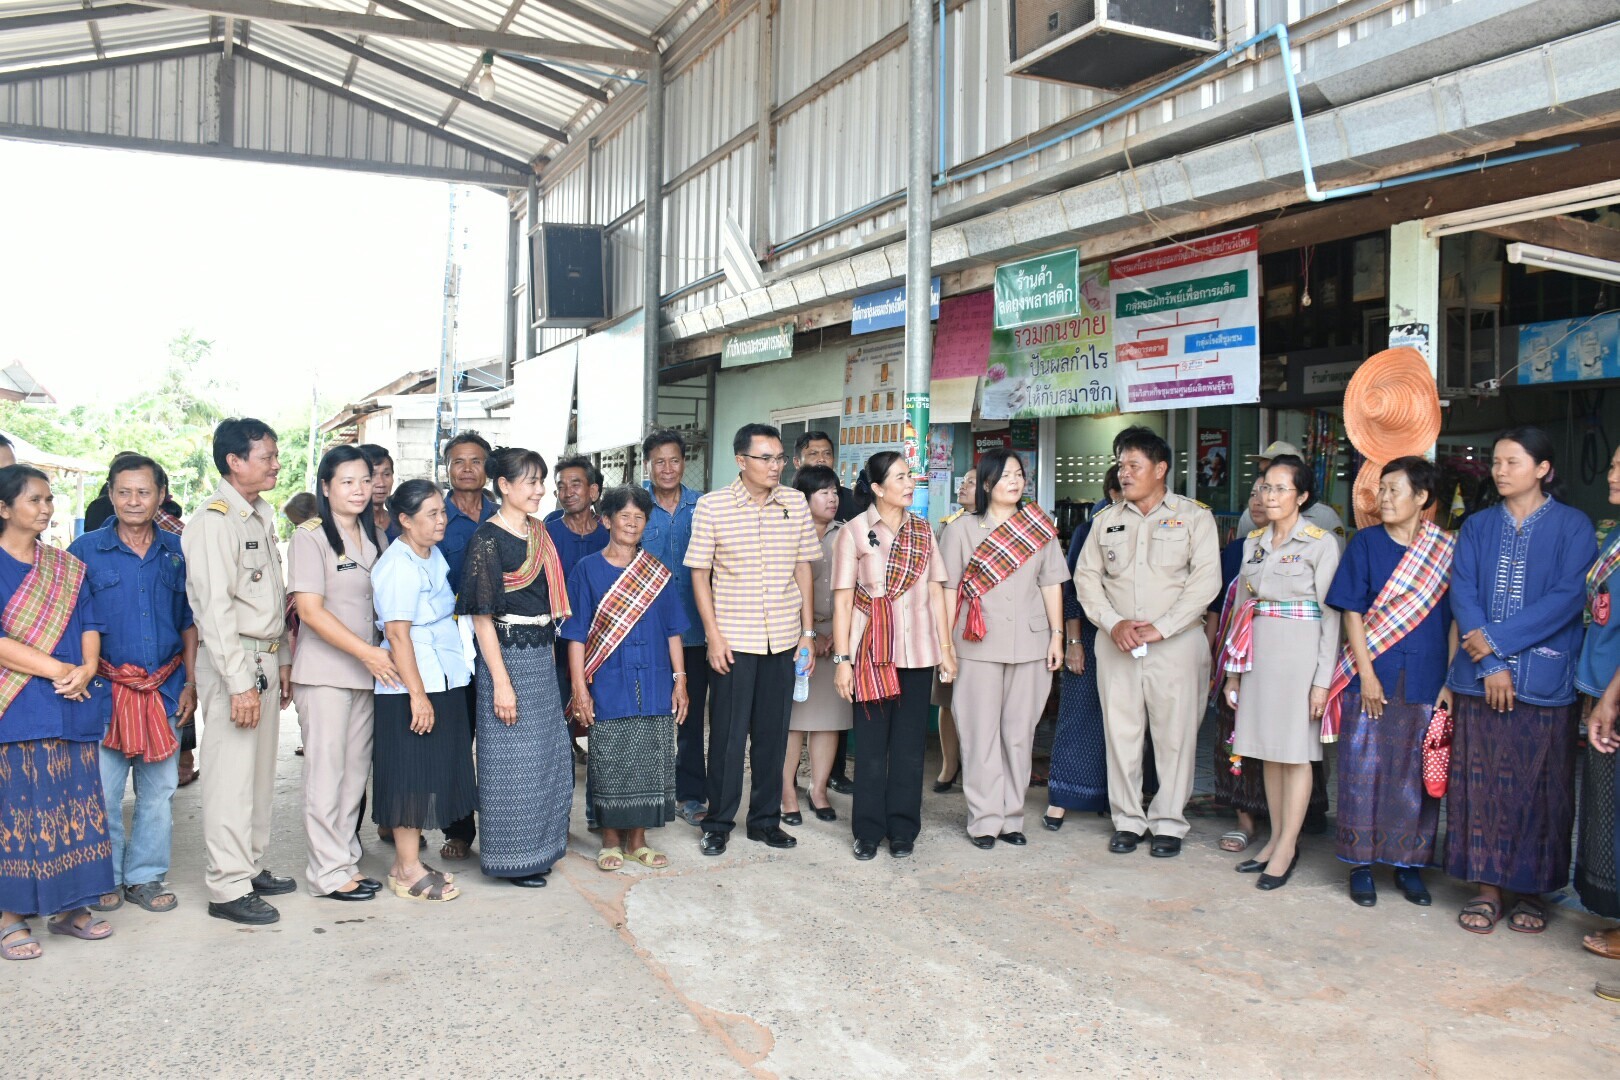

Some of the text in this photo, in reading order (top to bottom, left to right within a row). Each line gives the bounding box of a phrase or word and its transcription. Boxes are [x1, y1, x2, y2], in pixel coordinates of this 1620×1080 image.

[1017, 264, 1053, 290] ร้านค้า
[998, 283, 1073, 319] ลดถุงพลาสติก
[1125, 282, 1236, 313] กลุ่มออมทรัพย์เพื่อการผลิต
[1014, 315, 1107, 349] รวมกนขาย
[1029, 343, 1109, 377] ปันผลกำไร
[1026, 380, 1112, 408] ให้กับสมาชิก
